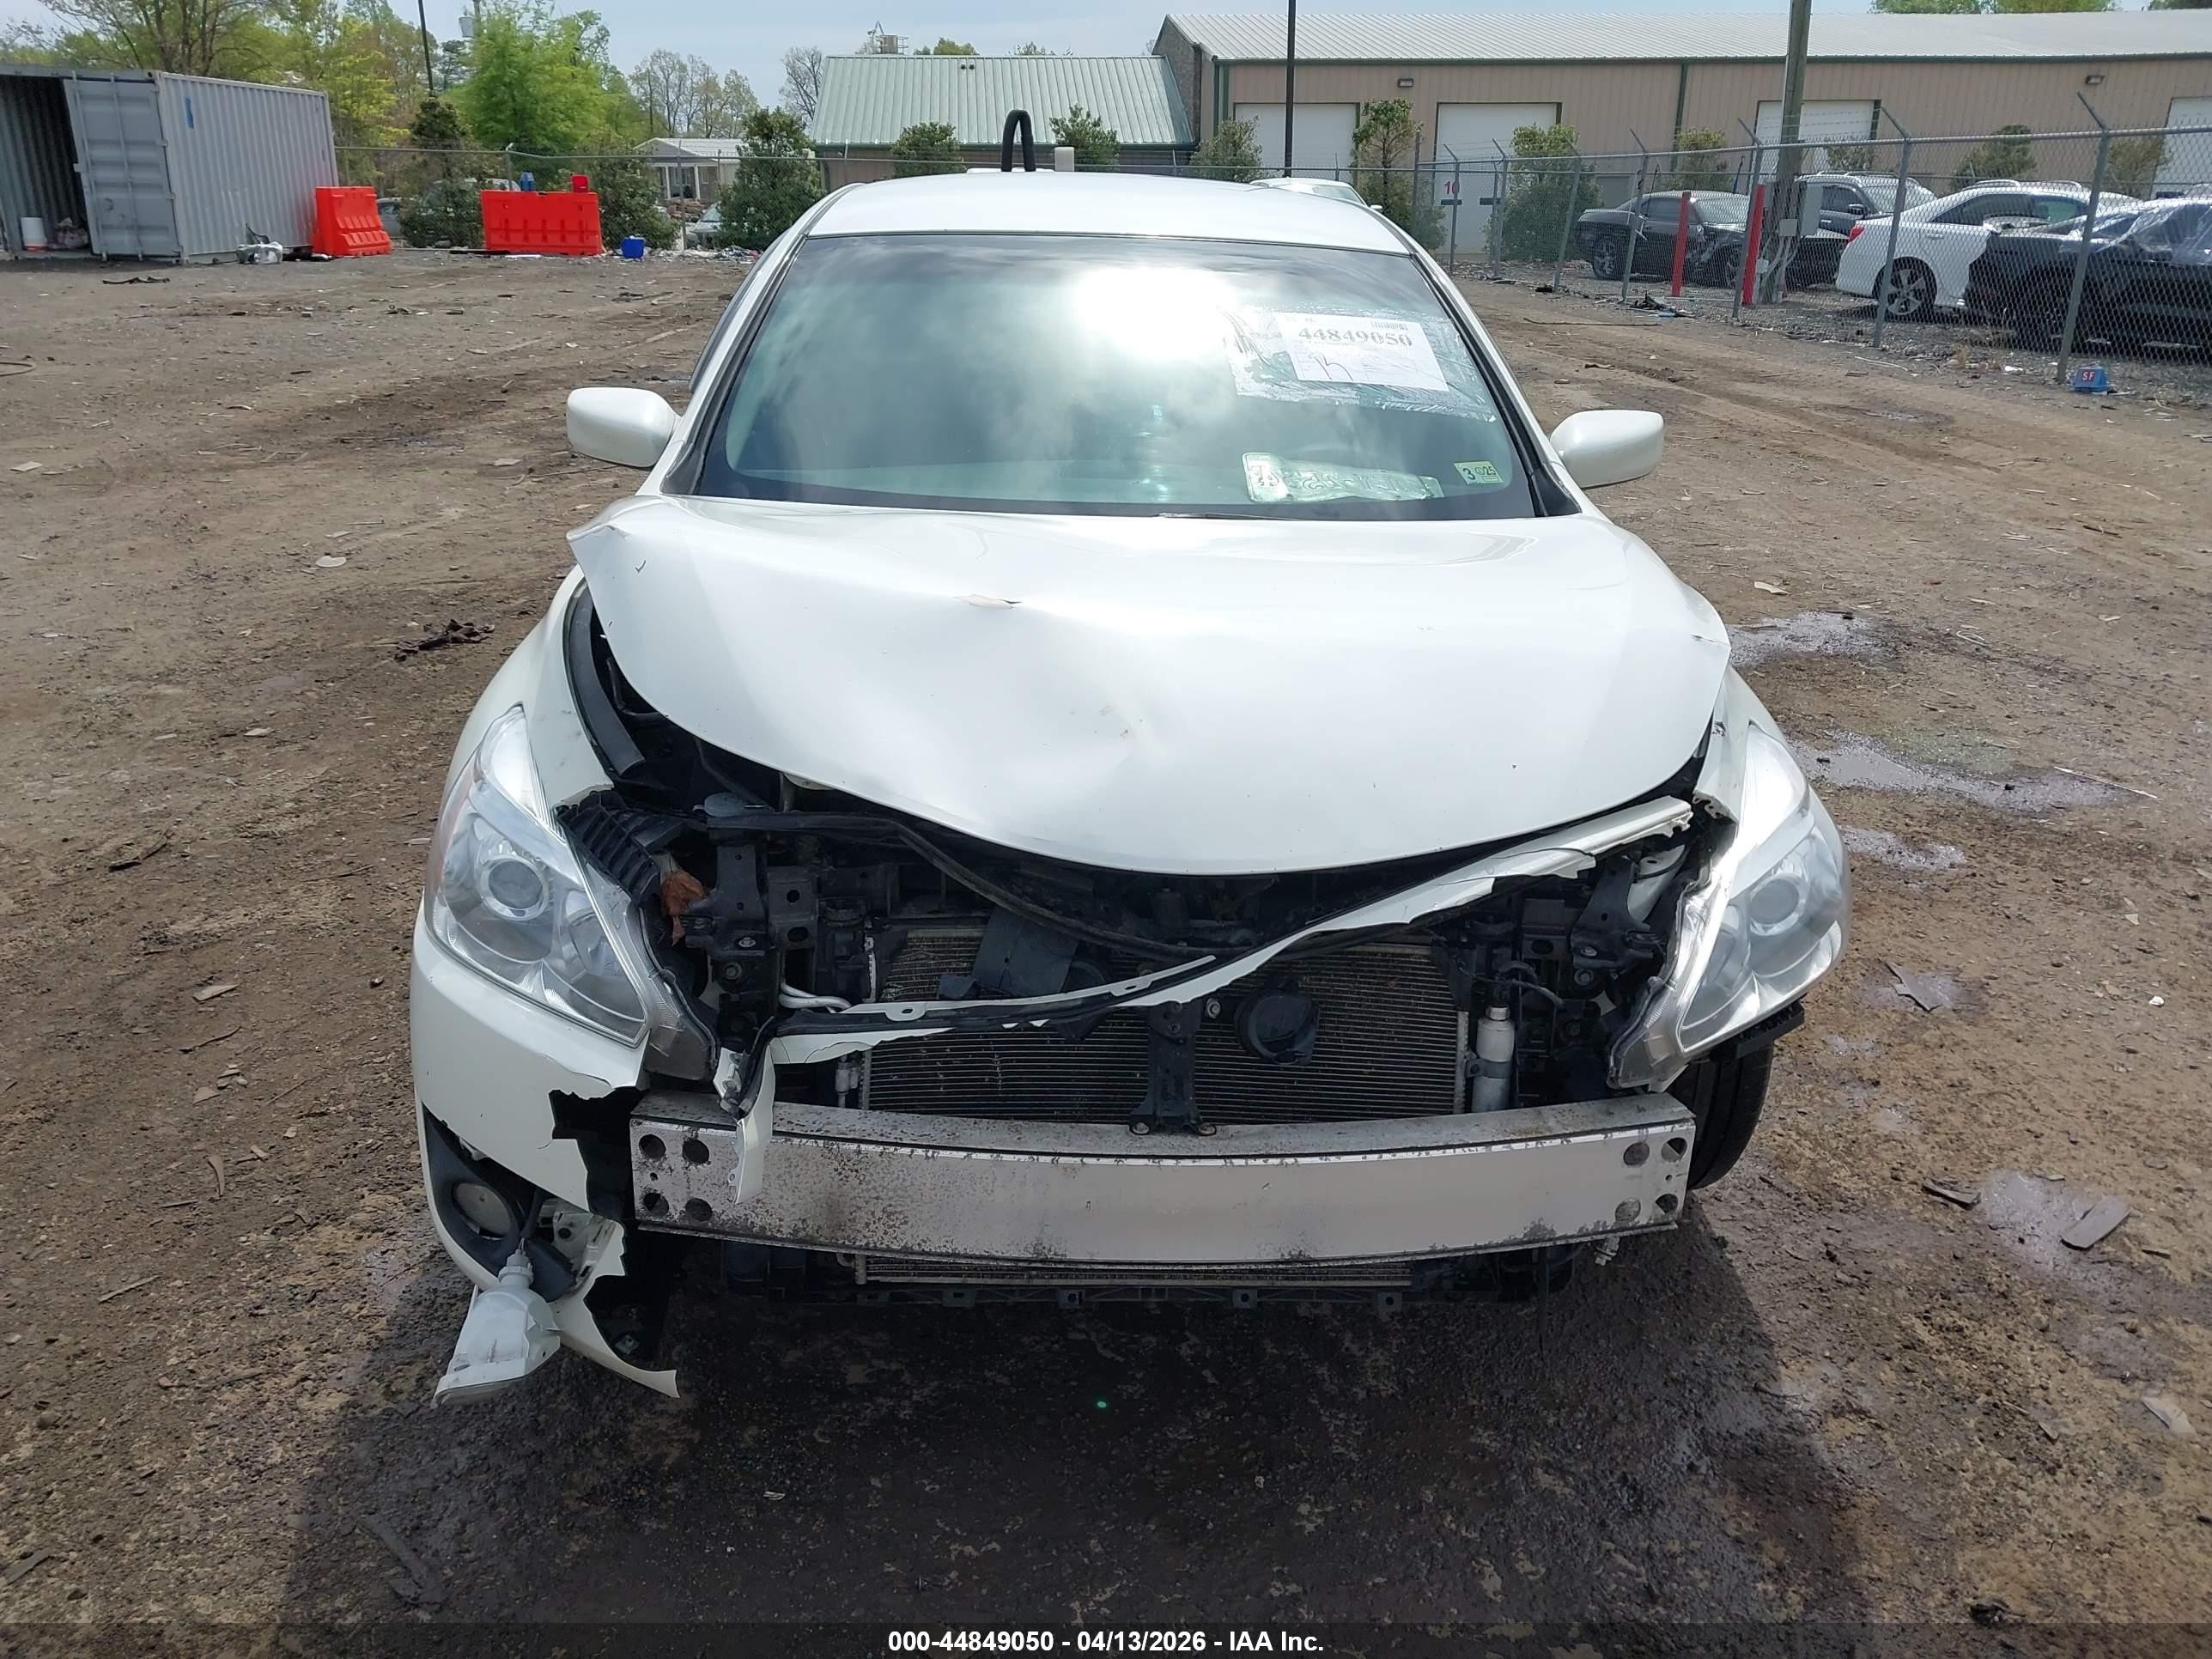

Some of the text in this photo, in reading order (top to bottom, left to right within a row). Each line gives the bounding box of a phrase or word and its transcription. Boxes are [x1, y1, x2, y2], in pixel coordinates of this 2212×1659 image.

[1297, 327, 1413, 347] 44849050
[2082, 371, 2095, 380] SF
[1462, 465, 1496, 481] 3 25
